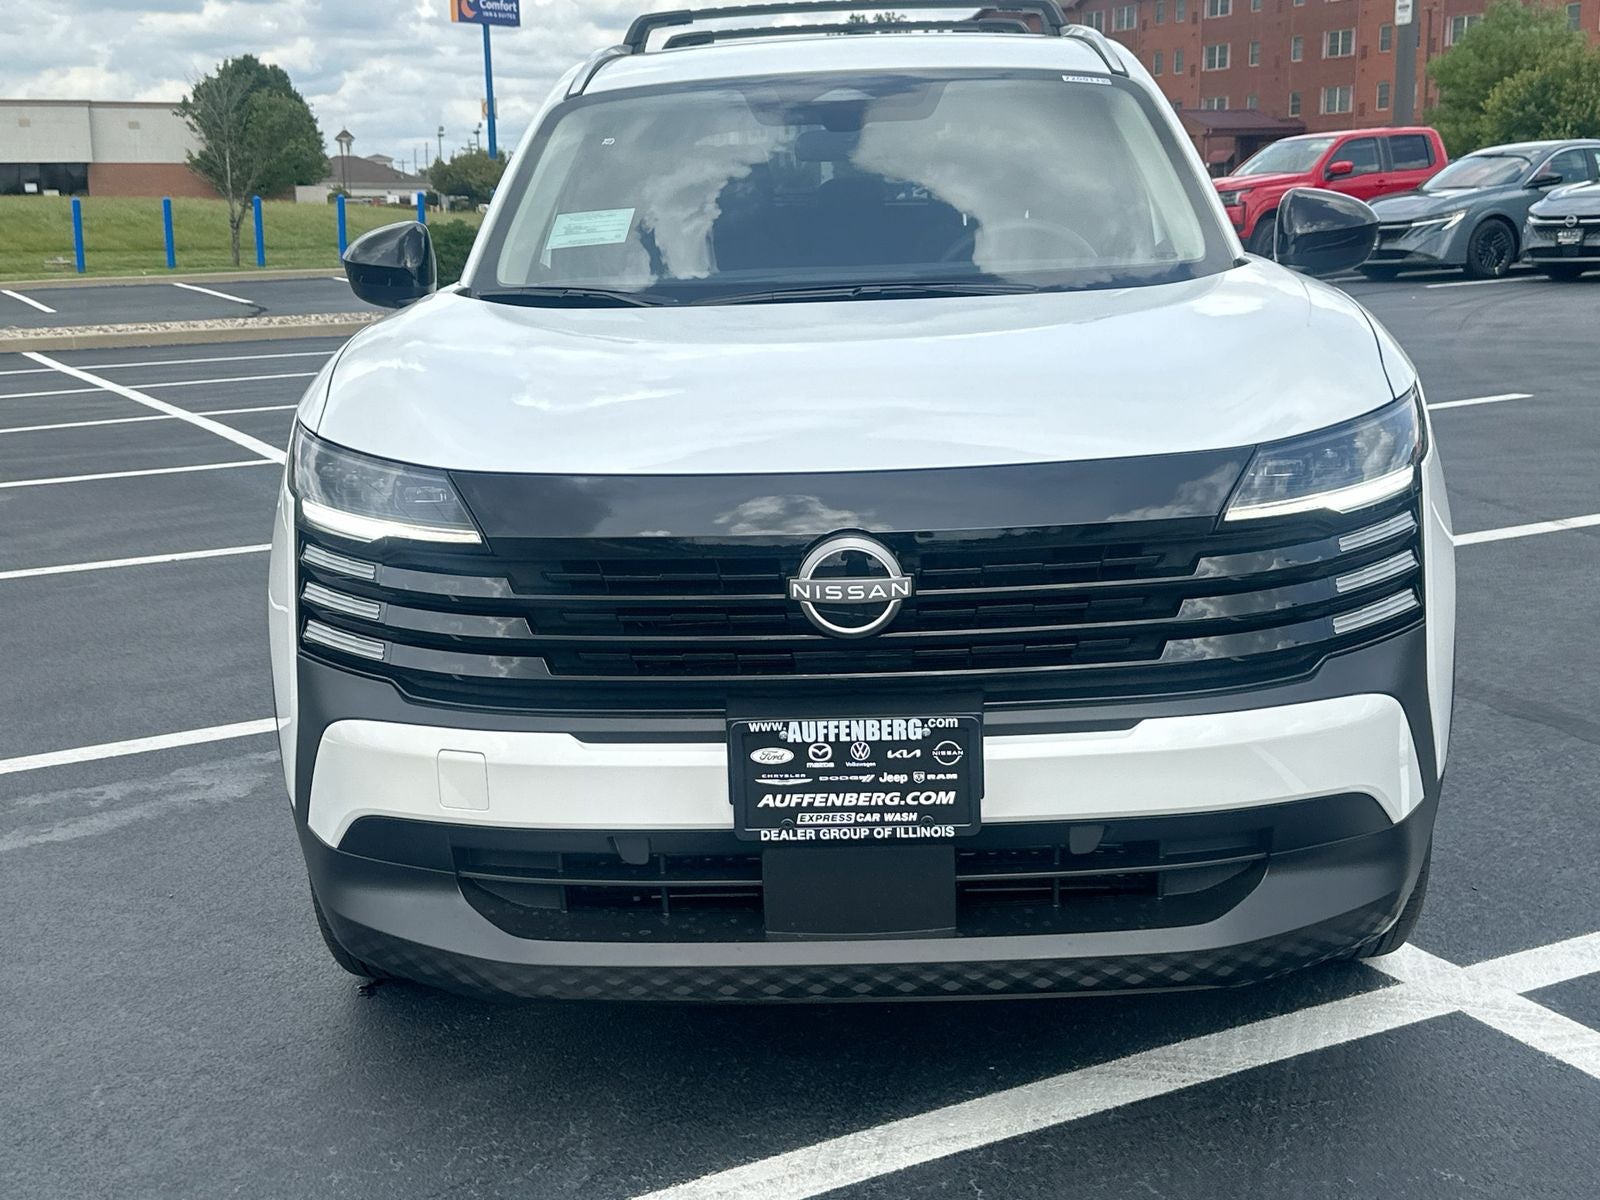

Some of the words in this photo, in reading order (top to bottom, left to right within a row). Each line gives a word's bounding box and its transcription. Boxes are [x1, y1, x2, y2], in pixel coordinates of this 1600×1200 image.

[479, 0, 517, 12] Comfort
[792, 581, 909, 600] NISSAN
[759, 750, 785, 761] Ford
[878, 772, 908, 784] Jeep
[756, 791, 956, 808] AUFFENBERG.COM
[799, 813, 854, 823] EXPRESS
[856, 813, 881, 822] CAR
[883, 812, 918, 822] WASH
[760, 829, 816, 841] DEALER
[819, 828, 870, 840] GROUP
[873, 827, 892, 839] OF
[896, 825, 955, 838] ILLINOIS
